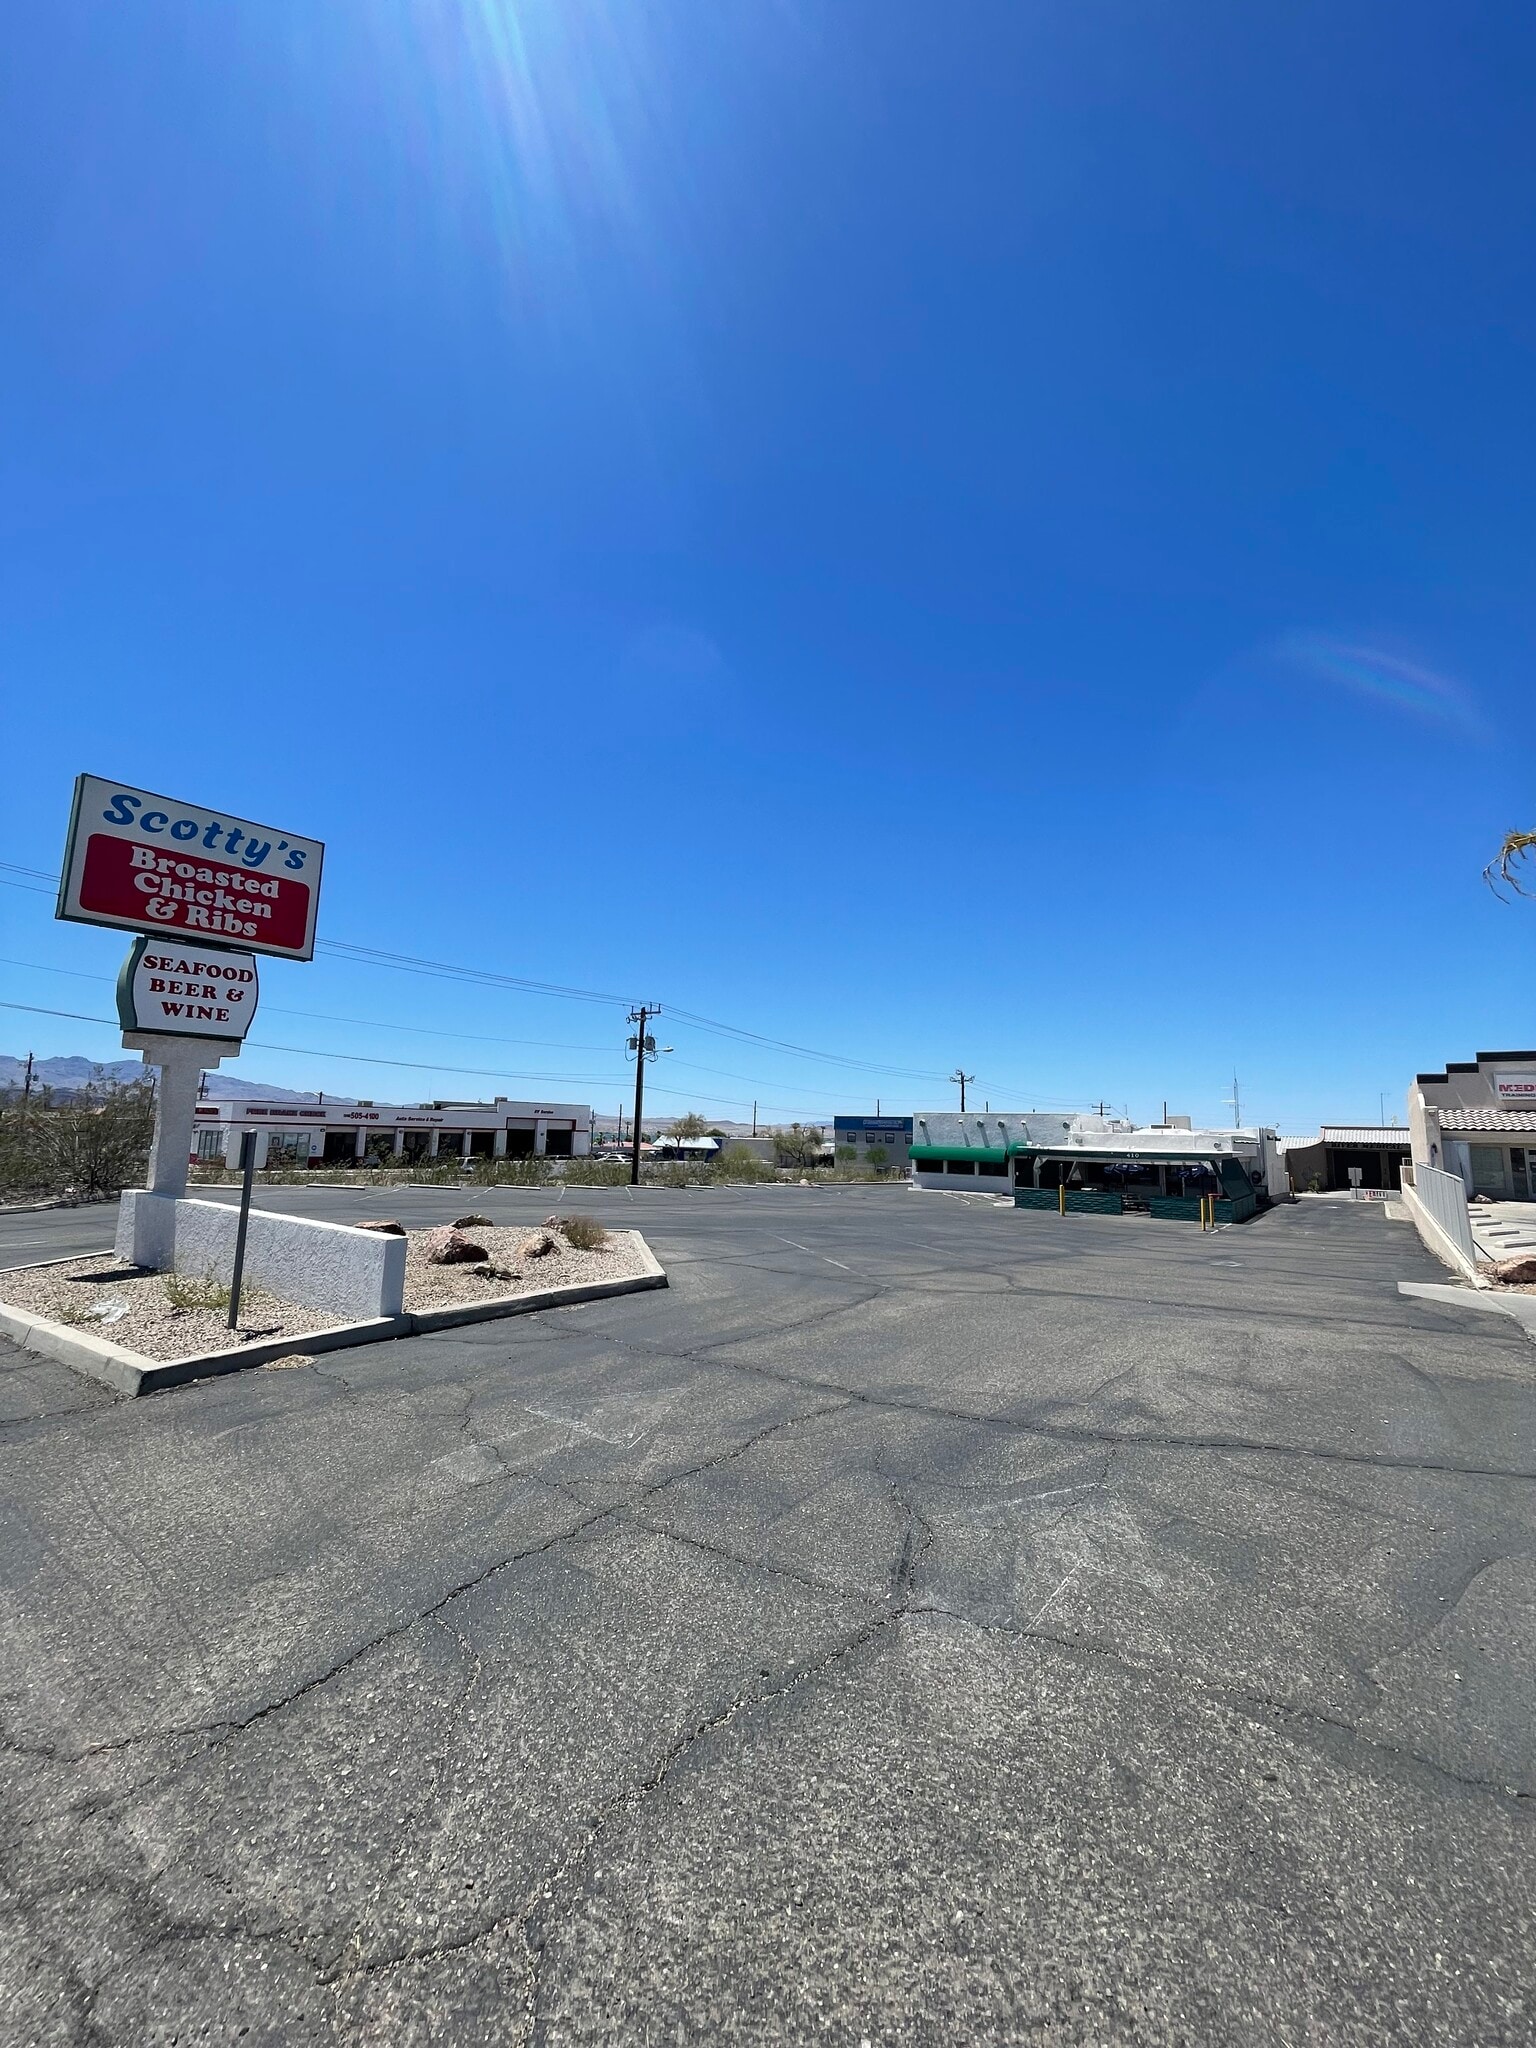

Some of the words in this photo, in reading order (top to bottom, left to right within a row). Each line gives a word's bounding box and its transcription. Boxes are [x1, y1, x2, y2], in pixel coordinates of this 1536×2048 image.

[103, 794, 307, 870] Scotty's
[129, 845, 279, 898] Broasted
[133, 872, 272, 919] Chicken
[145, 897, 178, 920] &
[184, 903, 258, 937] Ribs
[143, 954, 254, 983] SEAFOOD
[149, 977, 217, 1000] BEER
[226, 988, 245, 1002] &
[161, 1001, 230, 1022] WINE
[1499, 1084, 1536, 1092] MED
